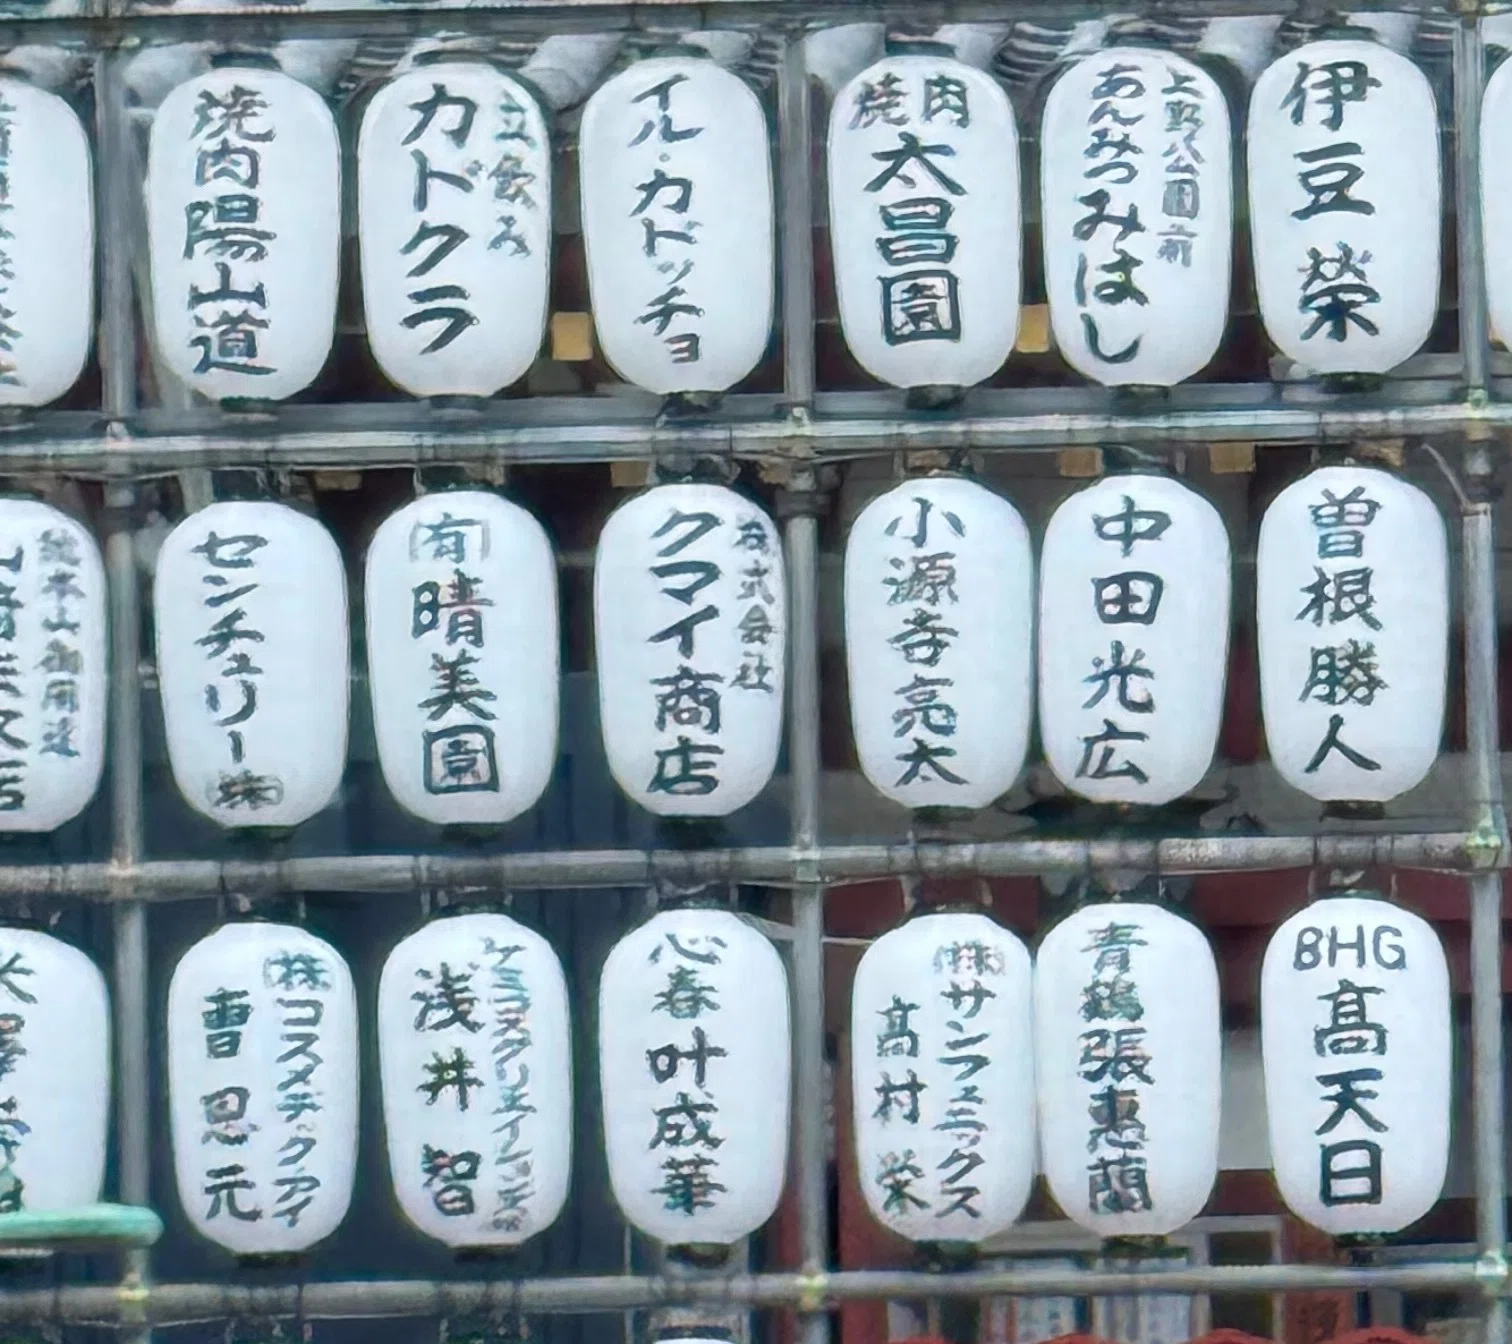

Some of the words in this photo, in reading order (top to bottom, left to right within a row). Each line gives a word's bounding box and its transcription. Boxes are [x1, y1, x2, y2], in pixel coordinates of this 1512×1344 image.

[175, 82, 278, 380] 焼肉陽山道
[398, 83, 482, 356] カドクラ
[864, 132, 967, 347] 大昌園
[642, 511, 725, 797] クマイ商店
[729, 515, 778, 694] 株式会社
[1072, 496, 1172, 786] 中田光広
[1295, 486, 1389, 776] 曽根勝人
[1293, 925, 1407, 971] BHG
